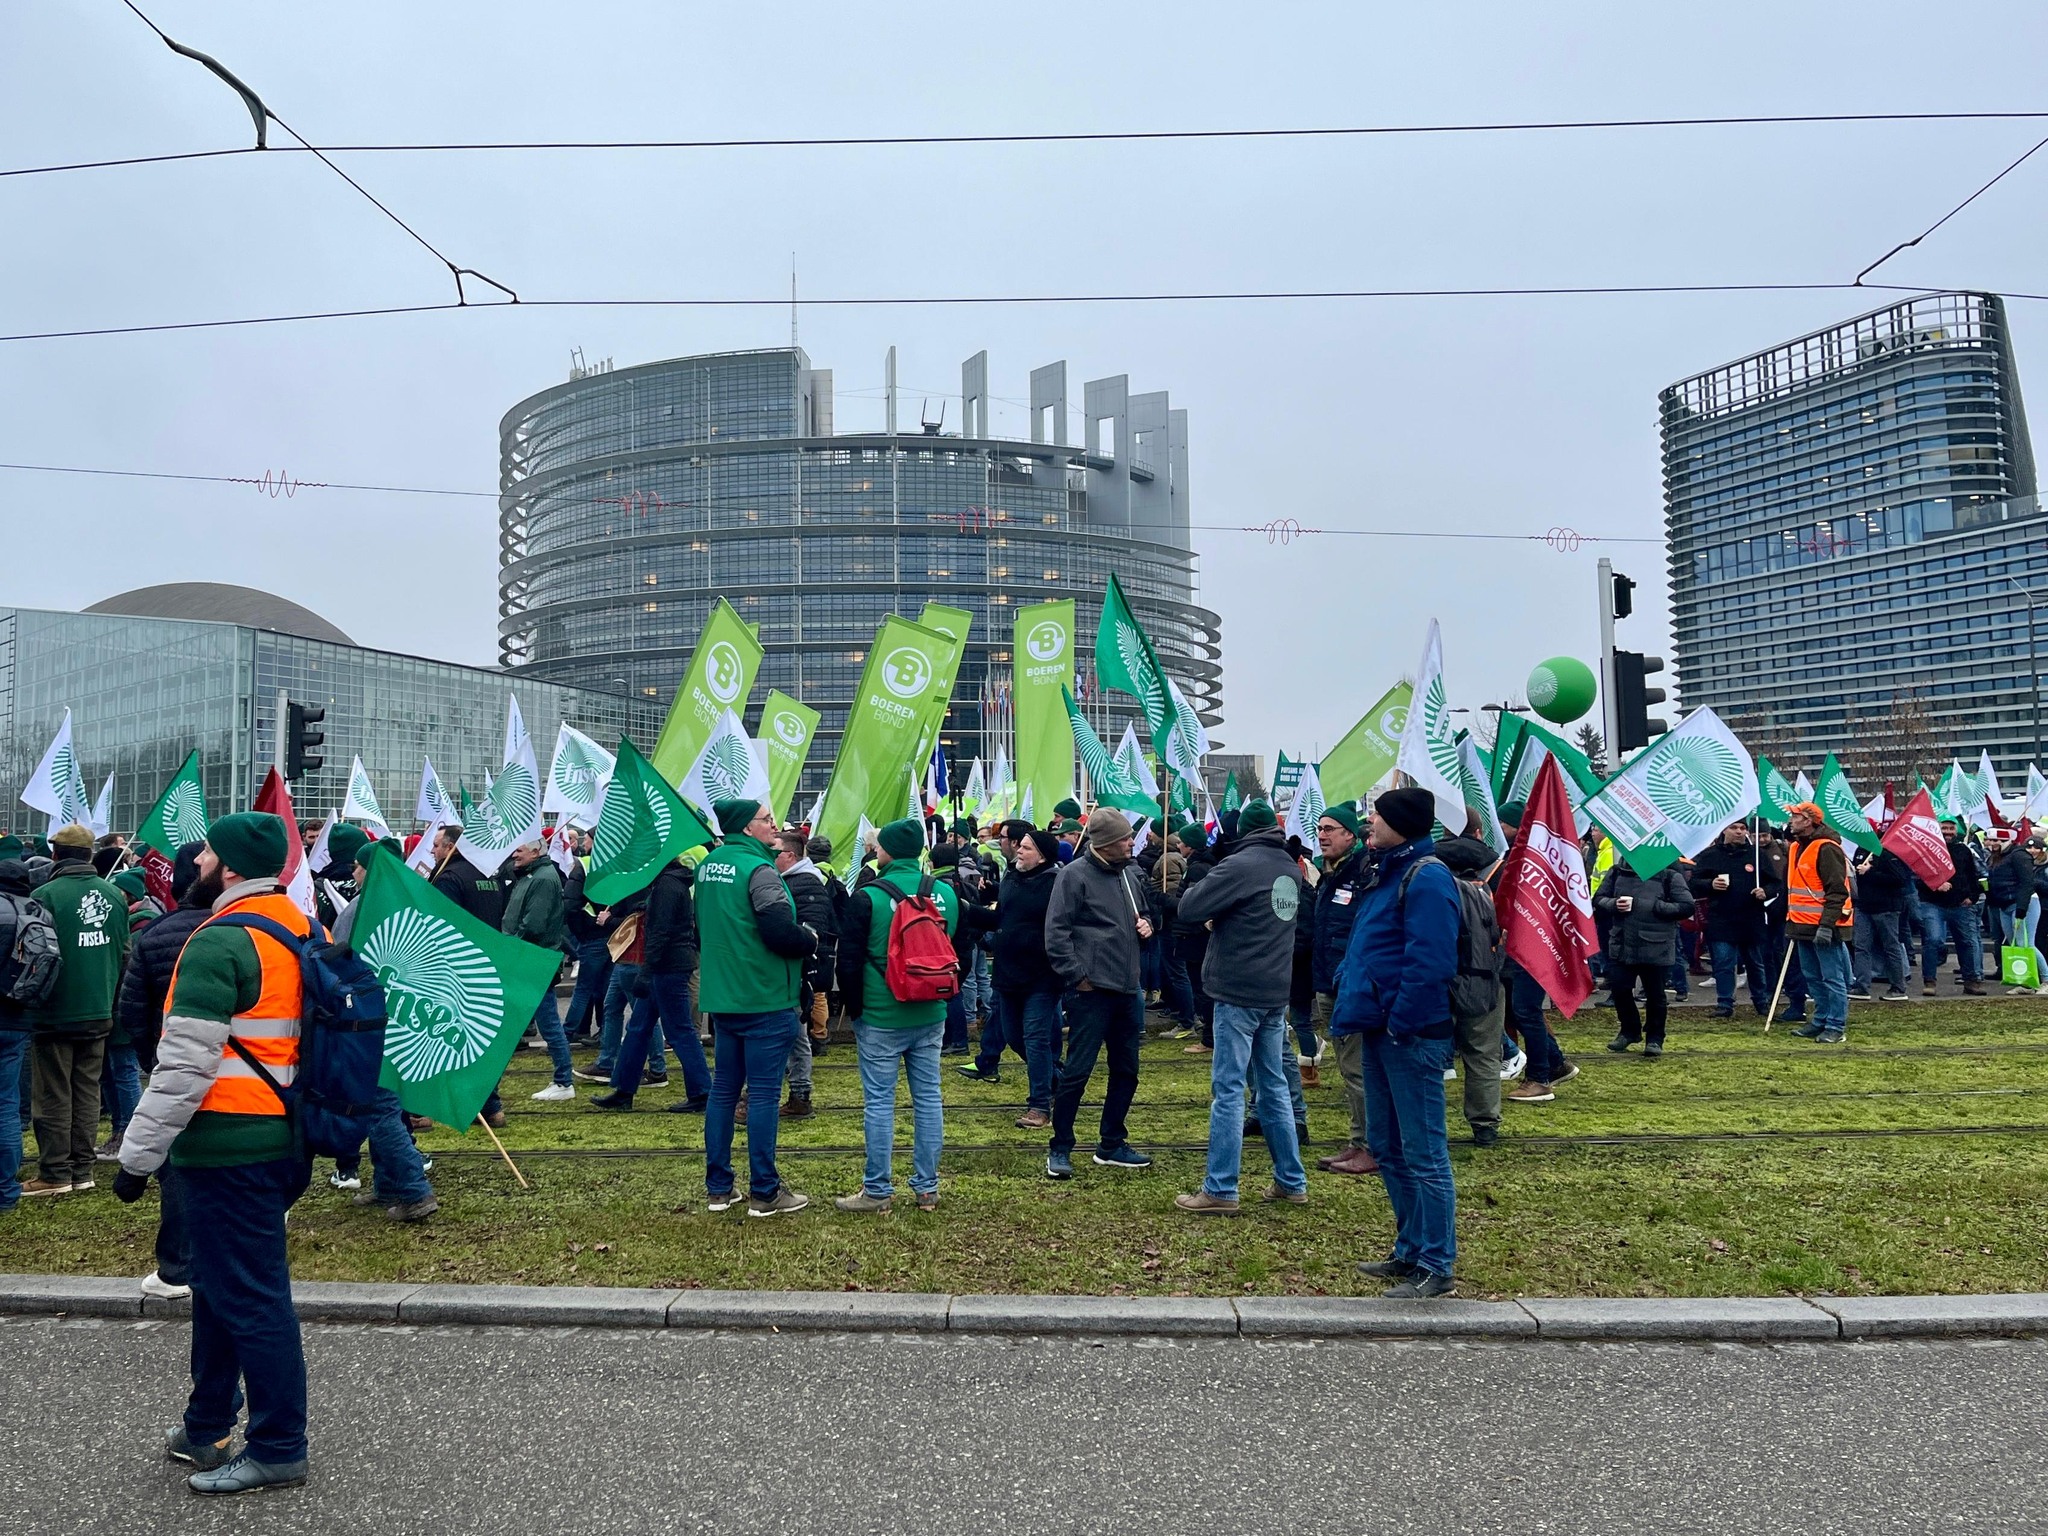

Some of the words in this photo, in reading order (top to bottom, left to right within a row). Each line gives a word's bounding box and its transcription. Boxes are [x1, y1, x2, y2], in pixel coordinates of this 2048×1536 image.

[1026, 663, 1066, 677] BOEREN
[692, 686, 723, 723] BOERE
[870, 694, 917, 720] BOEREN
[873, 708, 906, 730] BOND
[768, 737, 799, 761] BOEREN
[1364, 728, 1395, 758] BOEREN
[1656, 756, 1715, 819] fnsea
[1906, 825, 1955, 871] Agriculteurs
[706, 862, 736, 877] FDSEA
[377, 965, 468, 1056] fnsea
